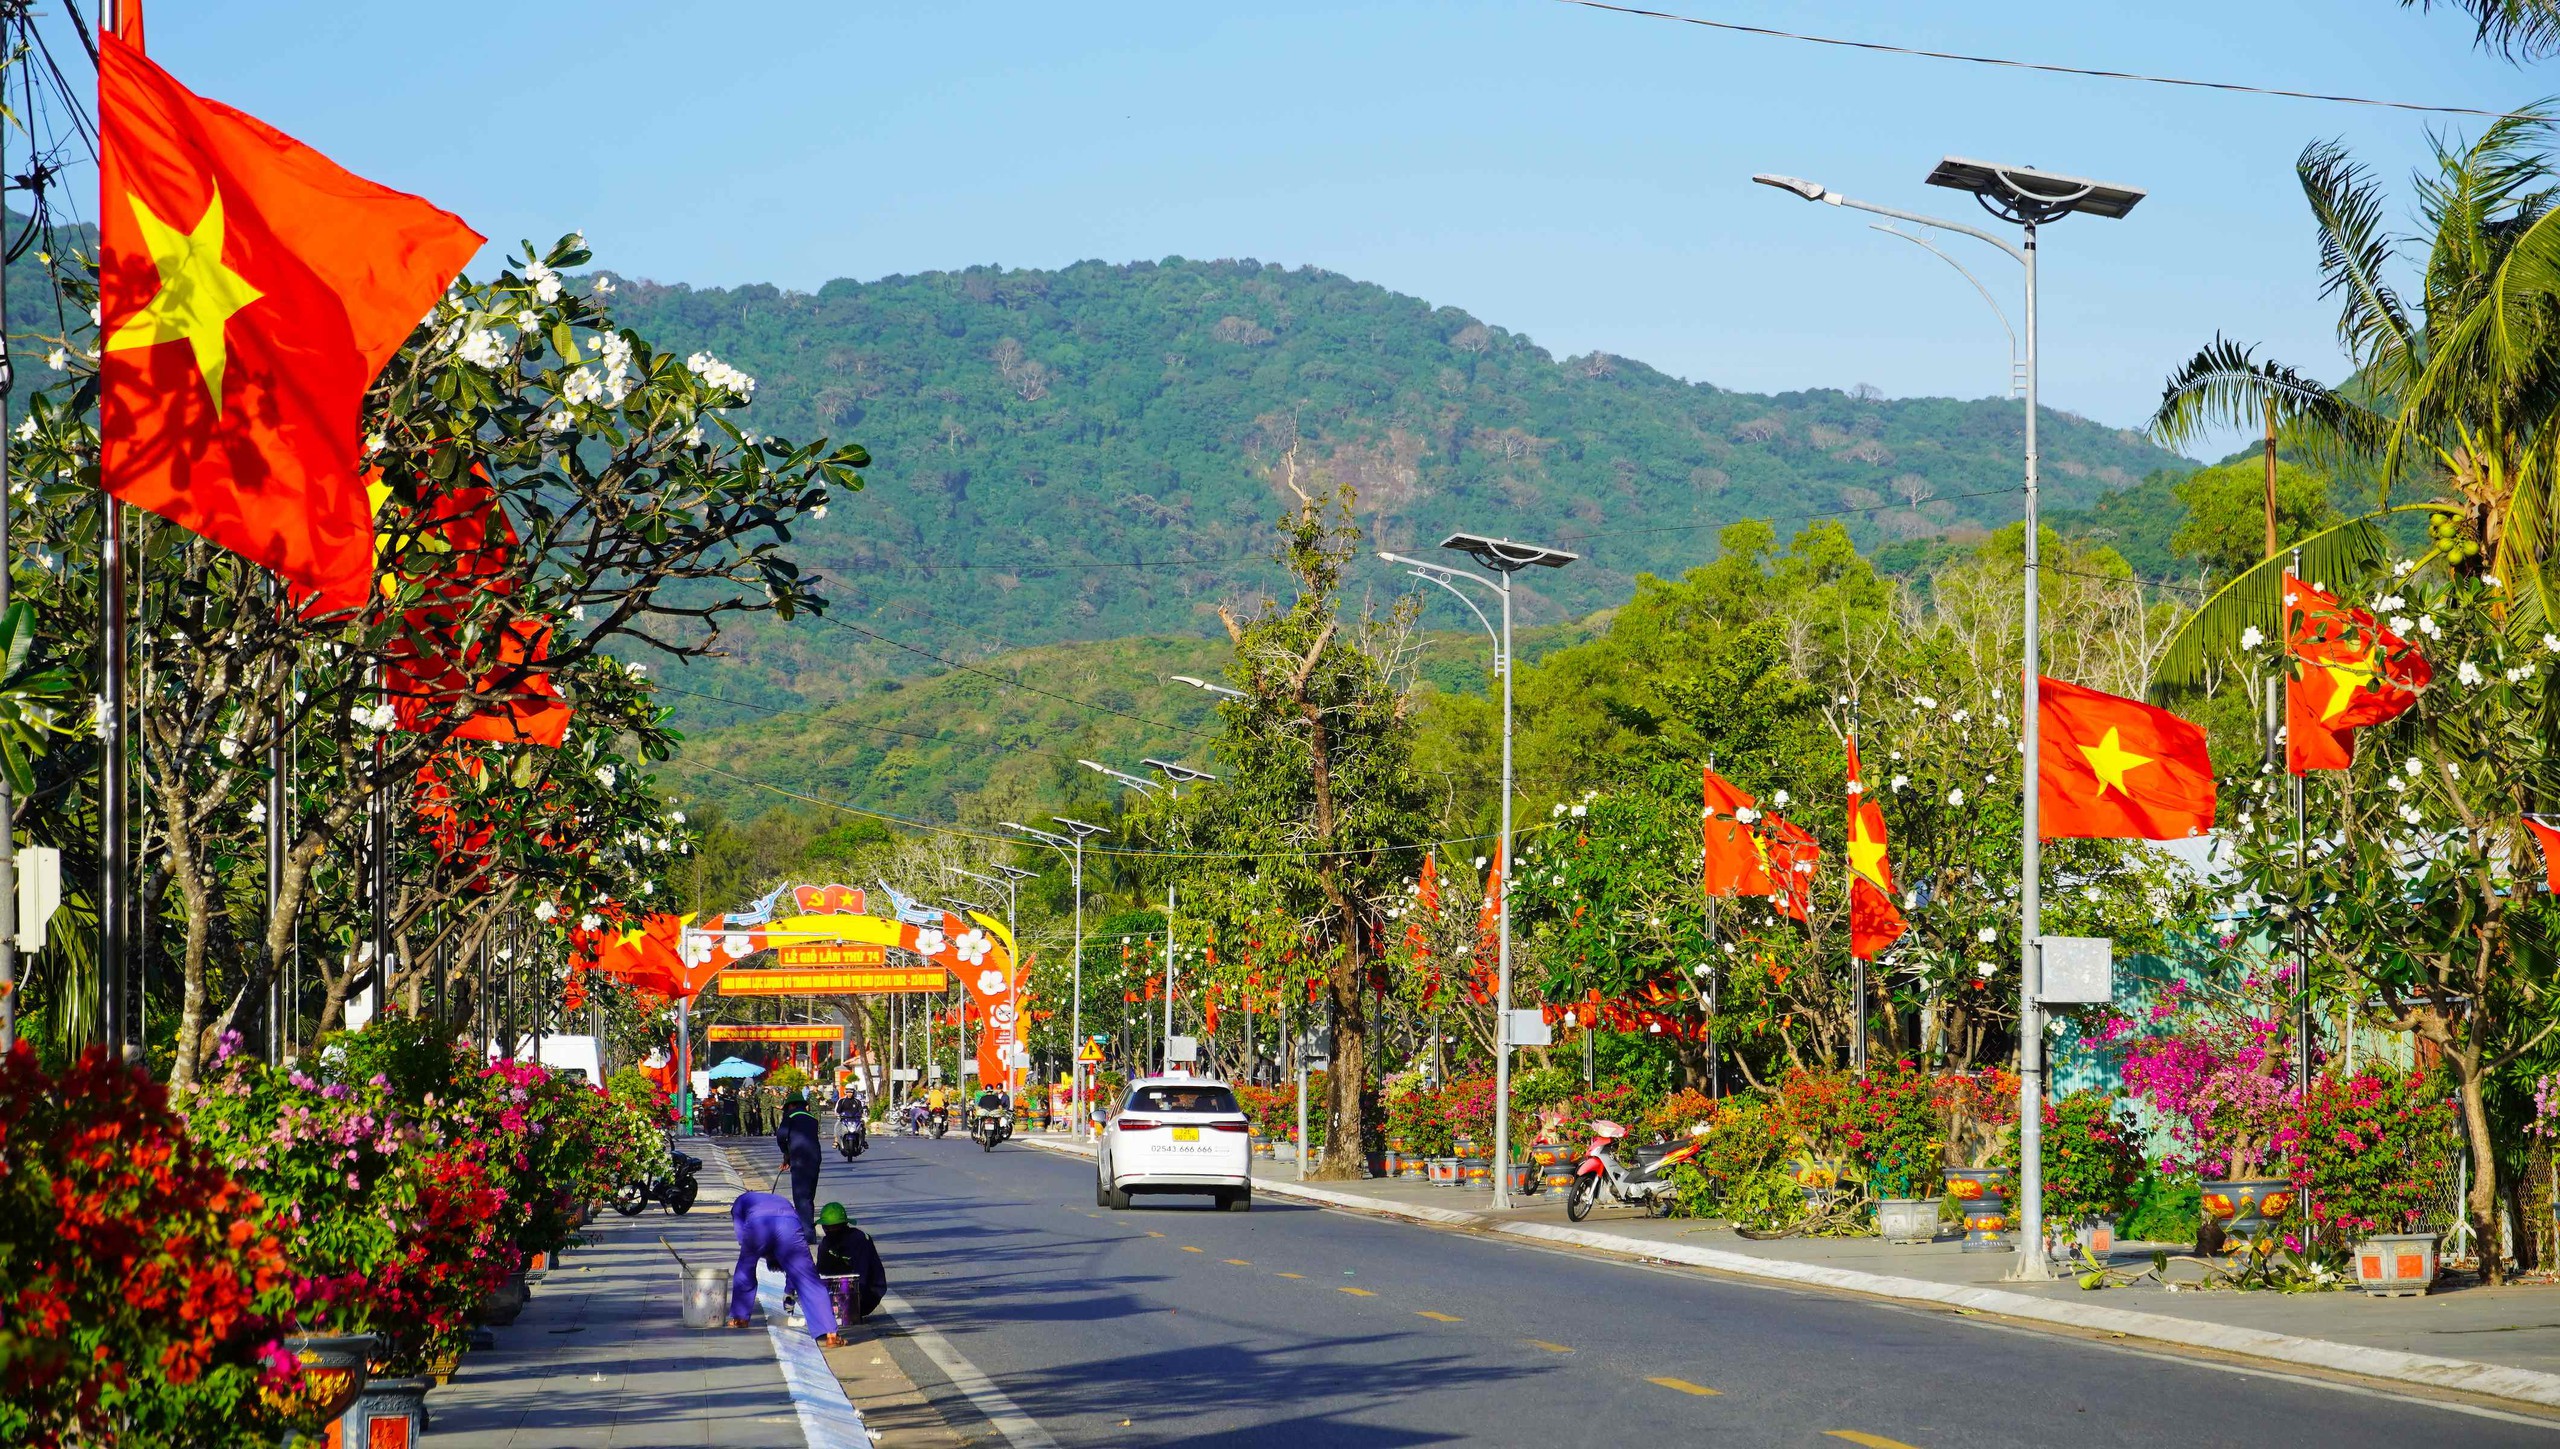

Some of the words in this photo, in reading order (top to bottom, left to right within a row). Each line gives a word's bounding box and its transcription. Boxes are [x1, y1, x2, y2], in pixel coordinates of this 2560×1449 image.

[784, 948, 798, 963] LỄ
[800, 948, 817, 963] GIỖ
[819, 948, 840, 963] LẦN
[843, 950, 865, 962] THỨ
[866, 951, 880, 962] 74
